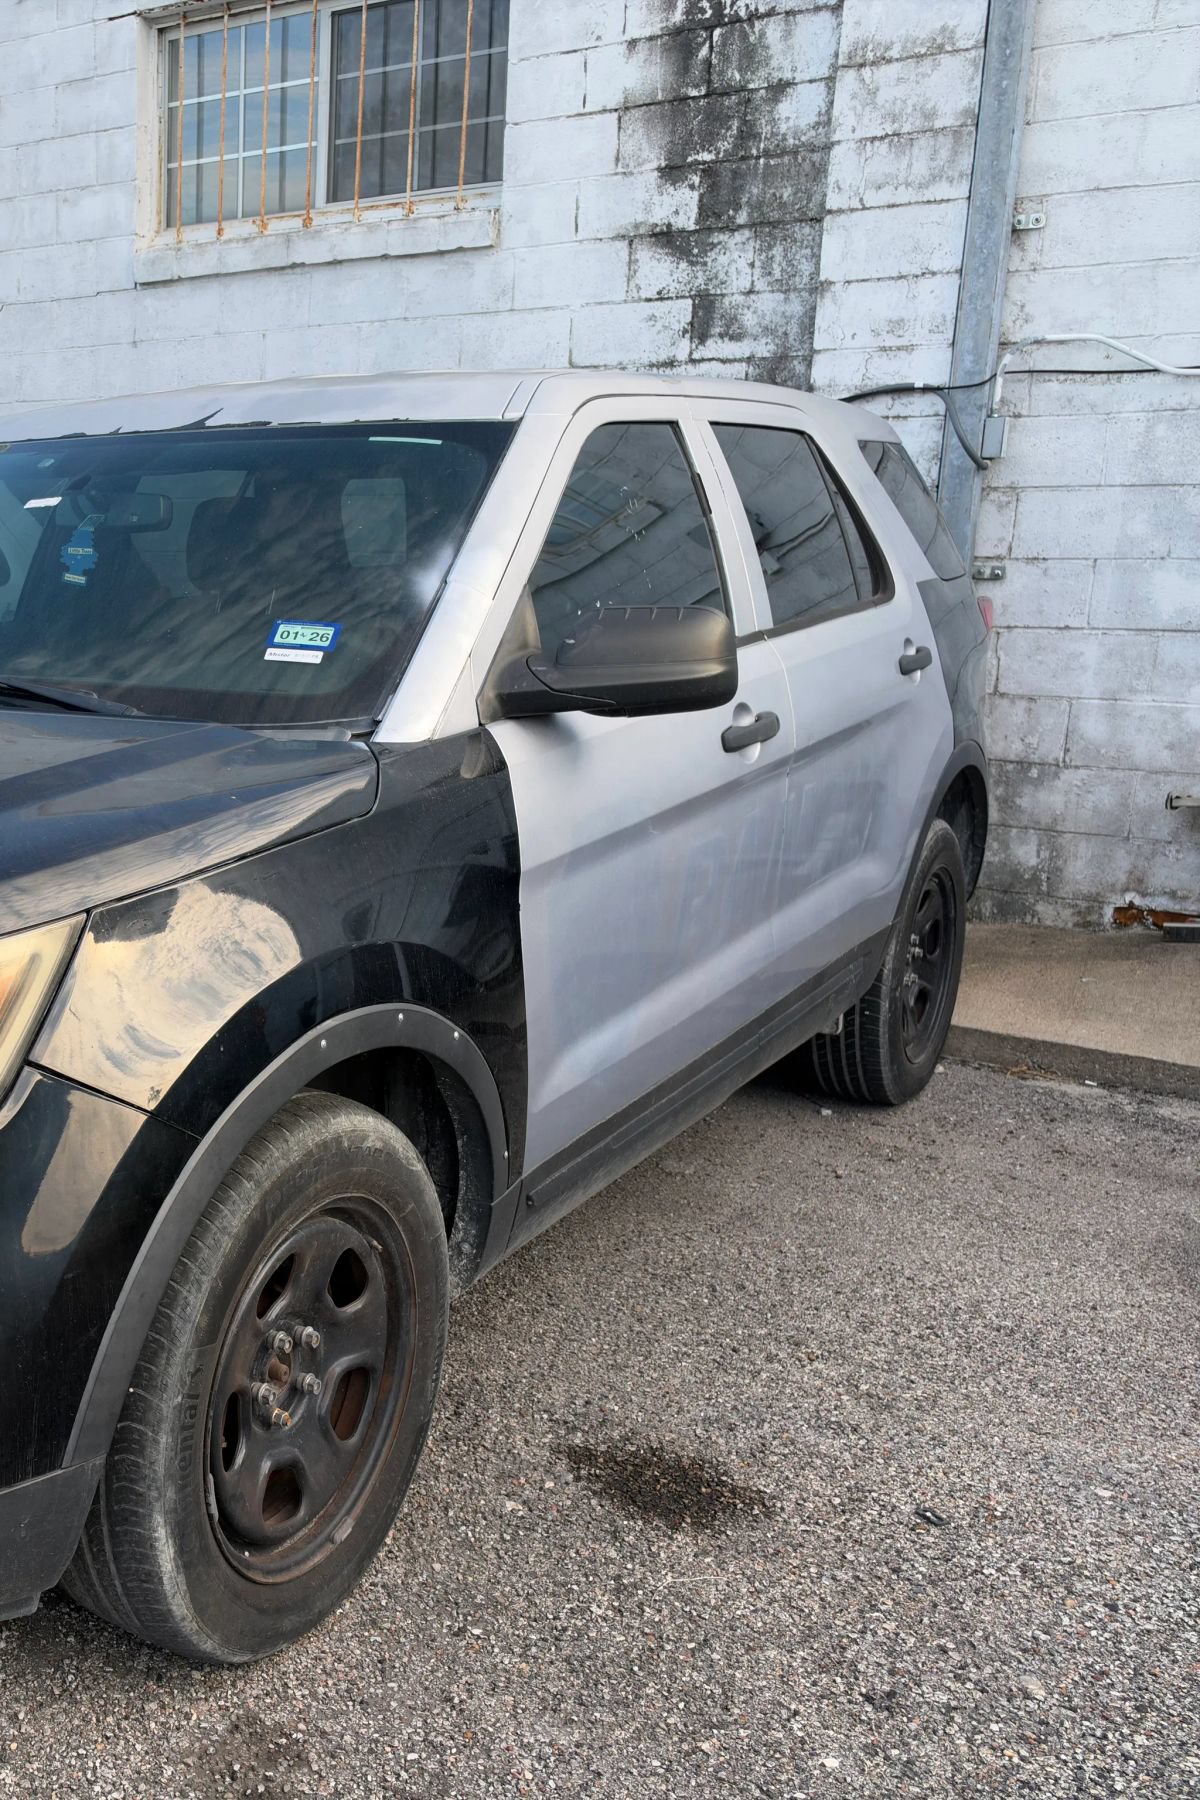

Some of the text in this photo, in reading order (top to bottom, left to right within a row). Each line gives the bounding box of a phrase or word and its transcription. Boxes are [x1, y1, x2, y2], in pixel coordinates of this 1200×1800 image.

[280, 630, 331, 643] 01 26
[176, 1391, 200, 1552] Cnental
